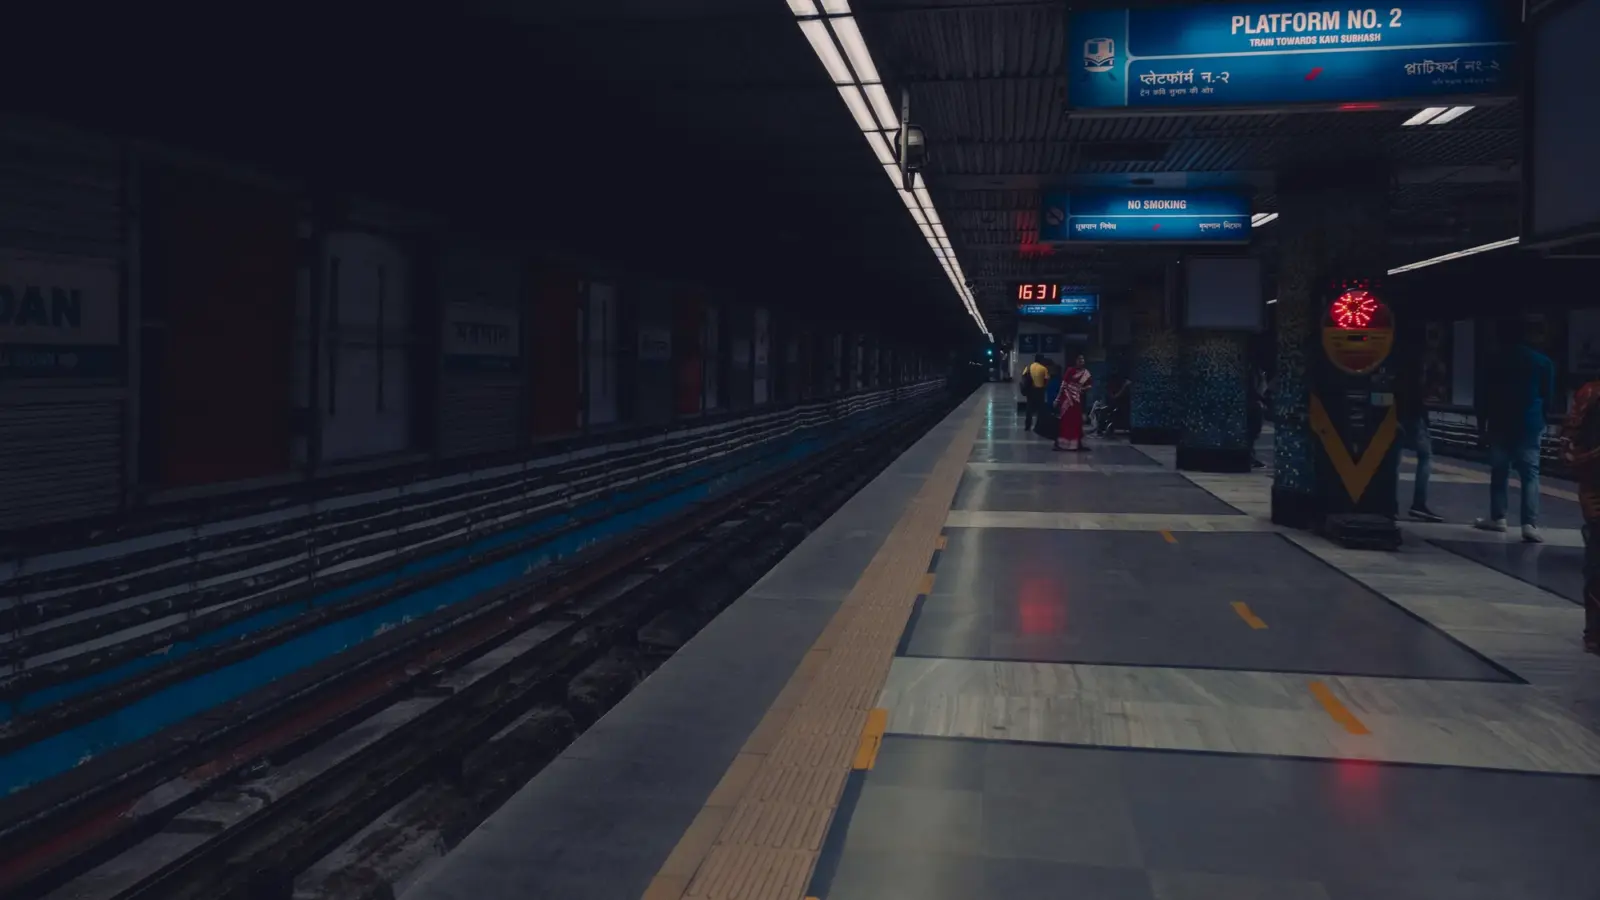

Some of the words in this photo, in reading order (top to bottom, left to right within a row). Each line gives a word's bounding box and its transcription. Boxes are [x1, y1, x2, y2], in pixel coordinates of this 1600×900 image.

[1231, 10, 1340, 35] PLATFORM
[1347, 8, 1382, 30] NO.
[1389, 7, 1402, 28] 2
[1250, 37, 1274, 47] TRAIN
[1276, 36, 1317, 46] TOWARDS
[1319, 35, 1339, 44] KAVI
[1341, 33, 1381, 43] SUBHASH
[1128, 200, 1141, 210] NO
[1143, 200, 1187, 210] SMOKING
